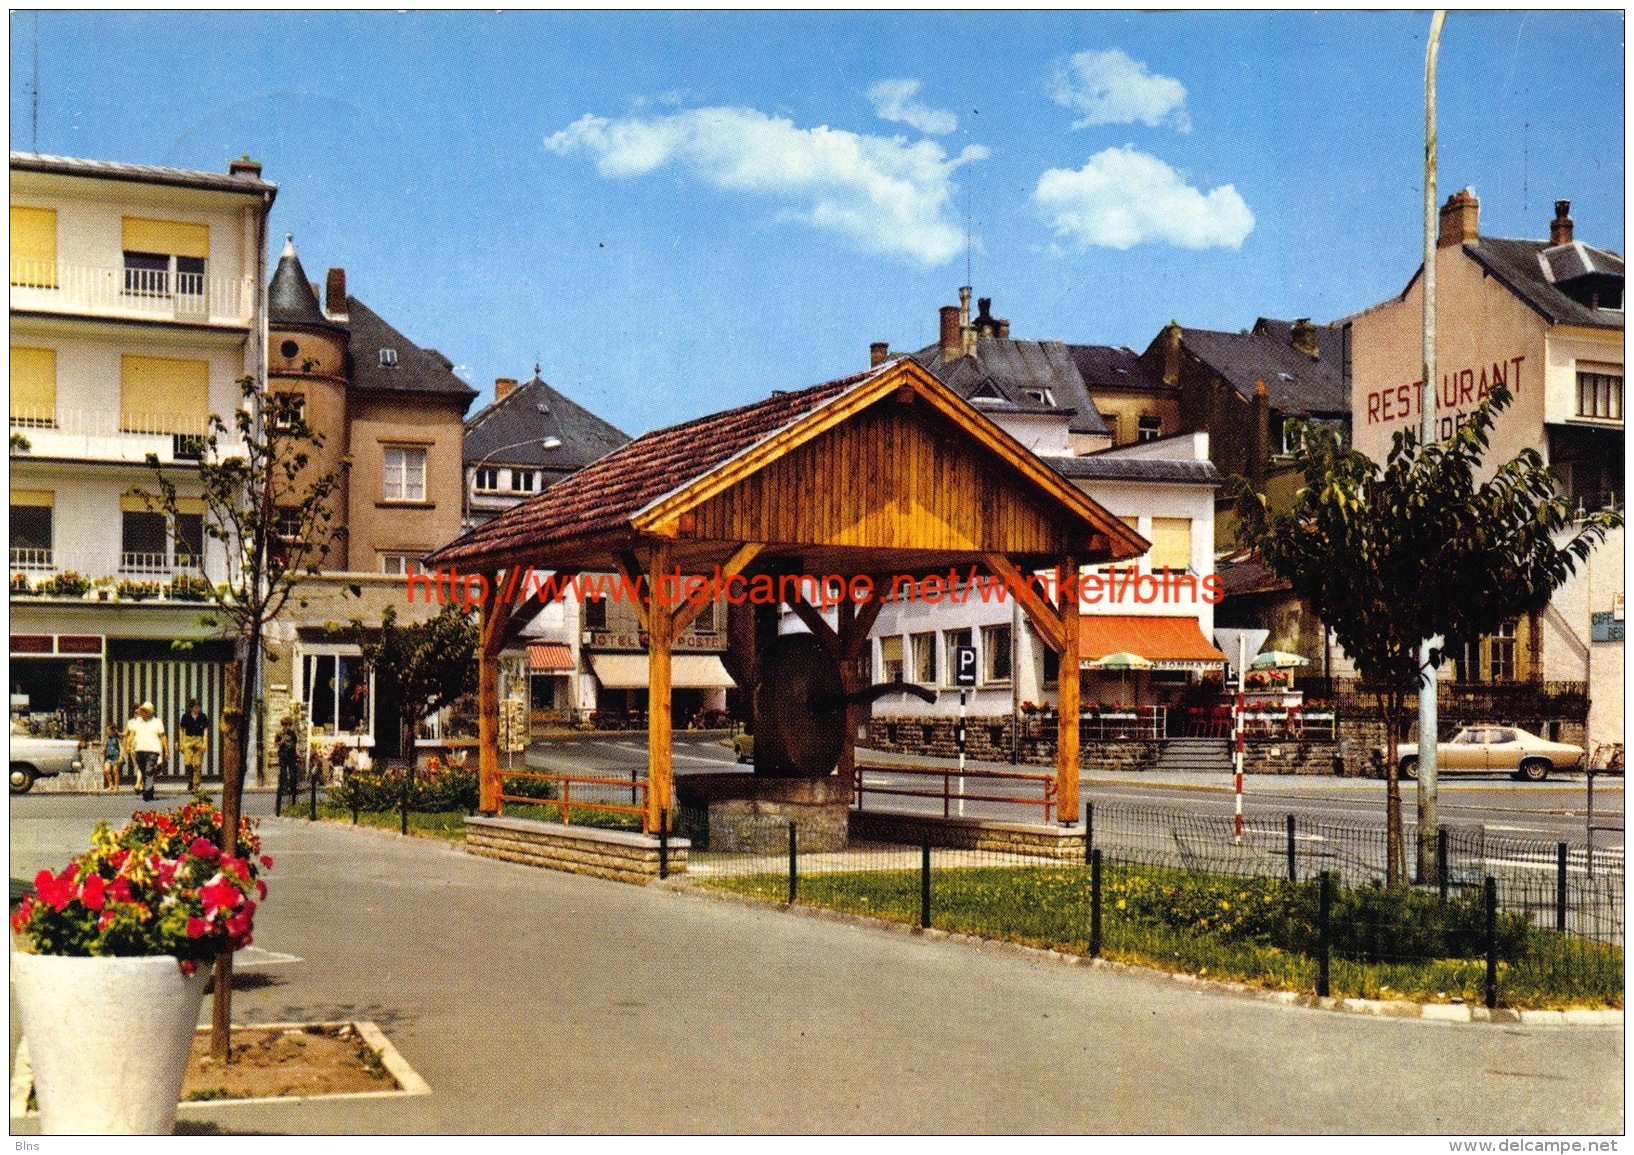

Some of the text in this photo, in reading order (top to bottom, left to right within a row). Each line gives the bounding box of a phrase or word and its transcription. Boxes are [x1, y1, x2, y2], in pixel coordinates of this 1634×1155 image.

[1367, 355, 1526, 425] RESTURANT
[595, 634, 637, 647] OTEL
[961, 650, 974, 671] P
